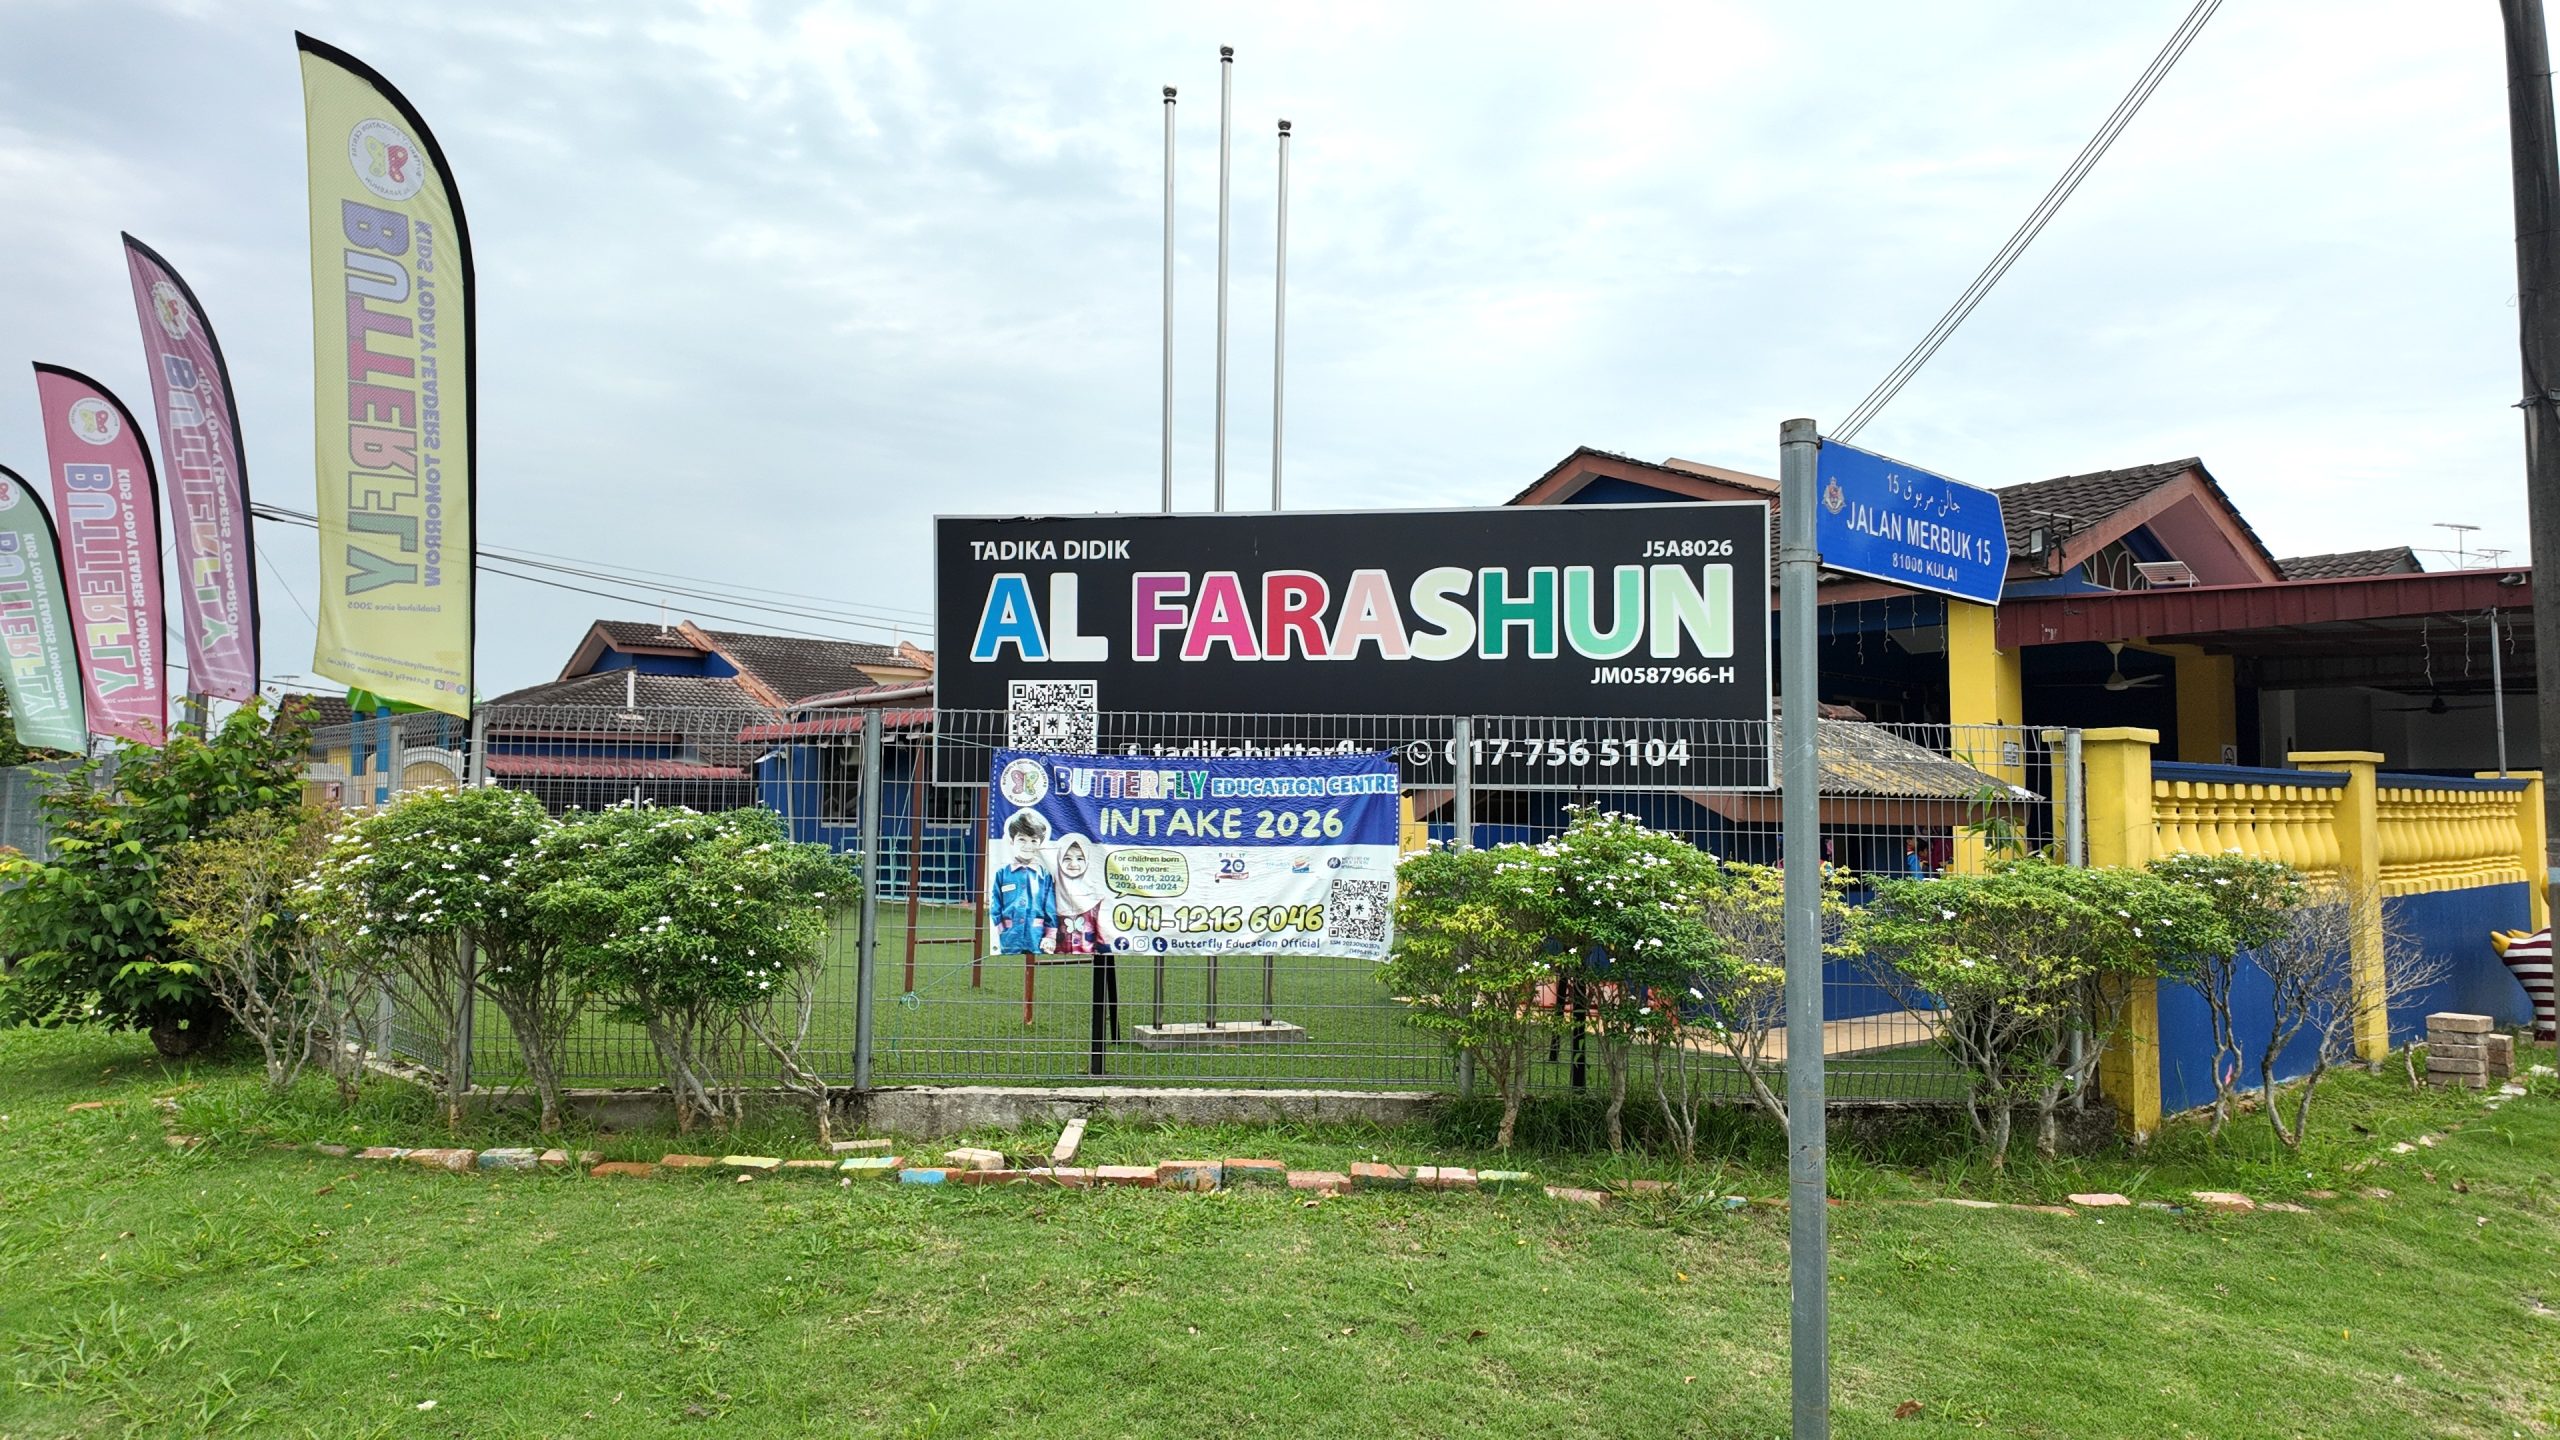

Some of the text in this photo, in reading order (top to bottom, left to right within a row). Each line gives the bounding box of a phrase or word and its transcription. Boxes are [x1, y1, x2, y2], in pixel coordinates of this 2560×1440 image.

[1887, 473, 1899, 494] 15
[1846, 501, 1991, 567] JALAN MERBUK 15
[970, 539, 1131, 561] TADIKA DIDIK
[1642, 539, 1734, 558] J5A8026
[1892, 552, 1958, 582] 81000 KULAI
[970, 565, 1735, 662] AL FARASHUN
[1590, 666, 1735, 685] JM0587966-H
[1599, 738, 1690, 766] 5104
[1053, 765, 1209, 800] BUTTERFLY
[1211, 777, 1325, 798] EDUCATION
[1327, 773, 1398, 796] CENTRE
[1100, 807, 1344, 839] INTAKE 2026
[1109, 873, 1184, 883] 2020, 2021, 2022,
[1113, 903, 1324, 933] 011-1216 6046
[1171, 937, 1320, 950] Butterfly Education Official
